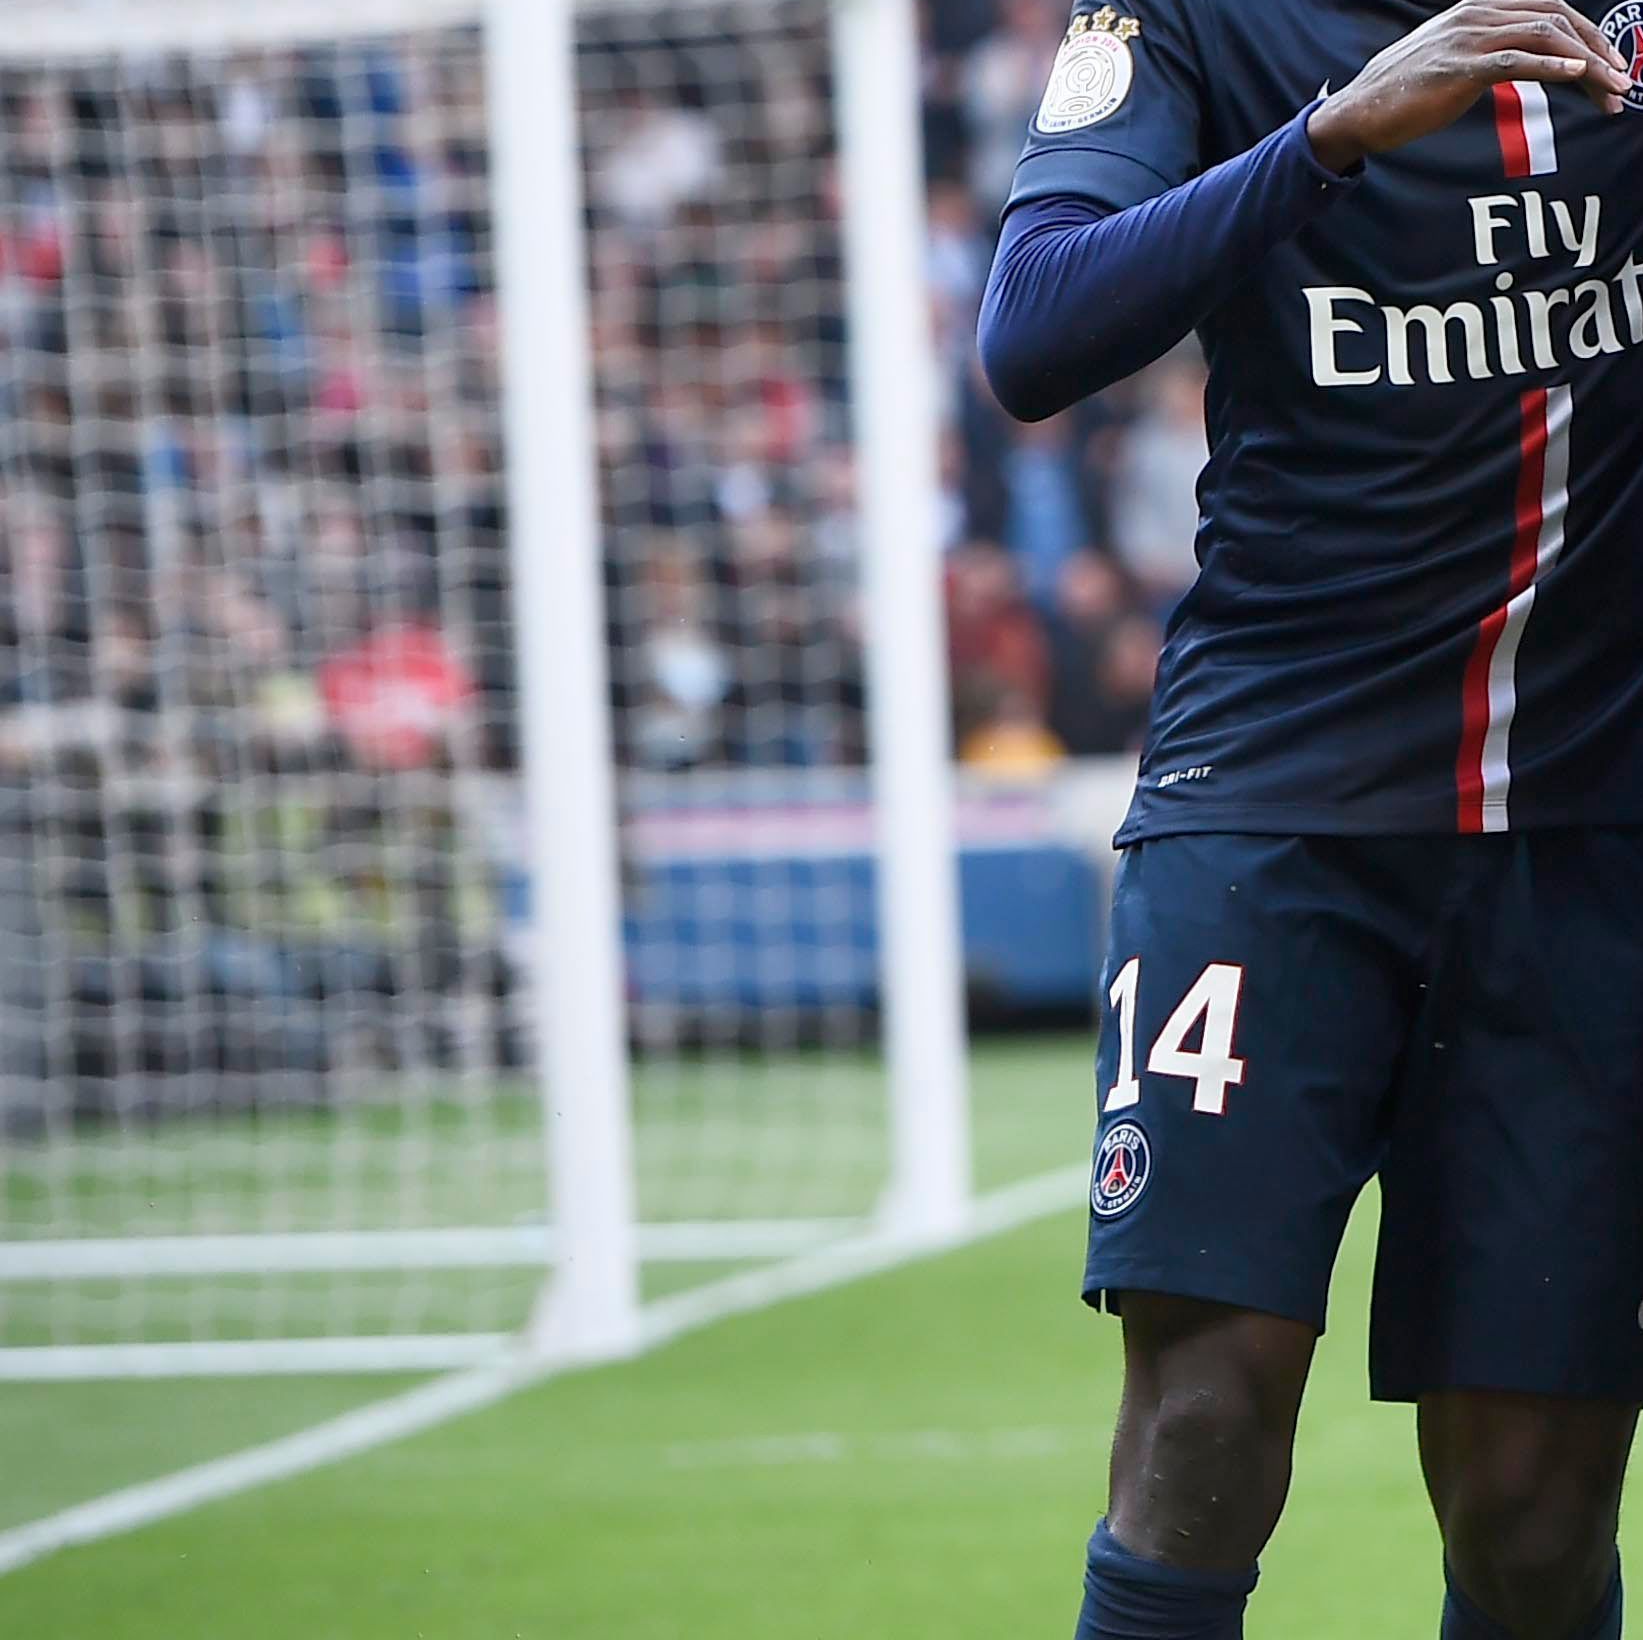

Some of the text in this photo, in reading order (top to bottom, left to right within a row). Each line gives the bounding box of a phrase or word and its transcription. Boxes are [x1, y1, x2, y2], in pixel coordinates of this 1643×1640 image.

[1468, 191, 1600, 268] Fly
[1157, 766, 1212, 788] DRI-FIT
[1103, 956, 1246, 1115] 14
[1103, 1129, 1141, 1153] PARIS
